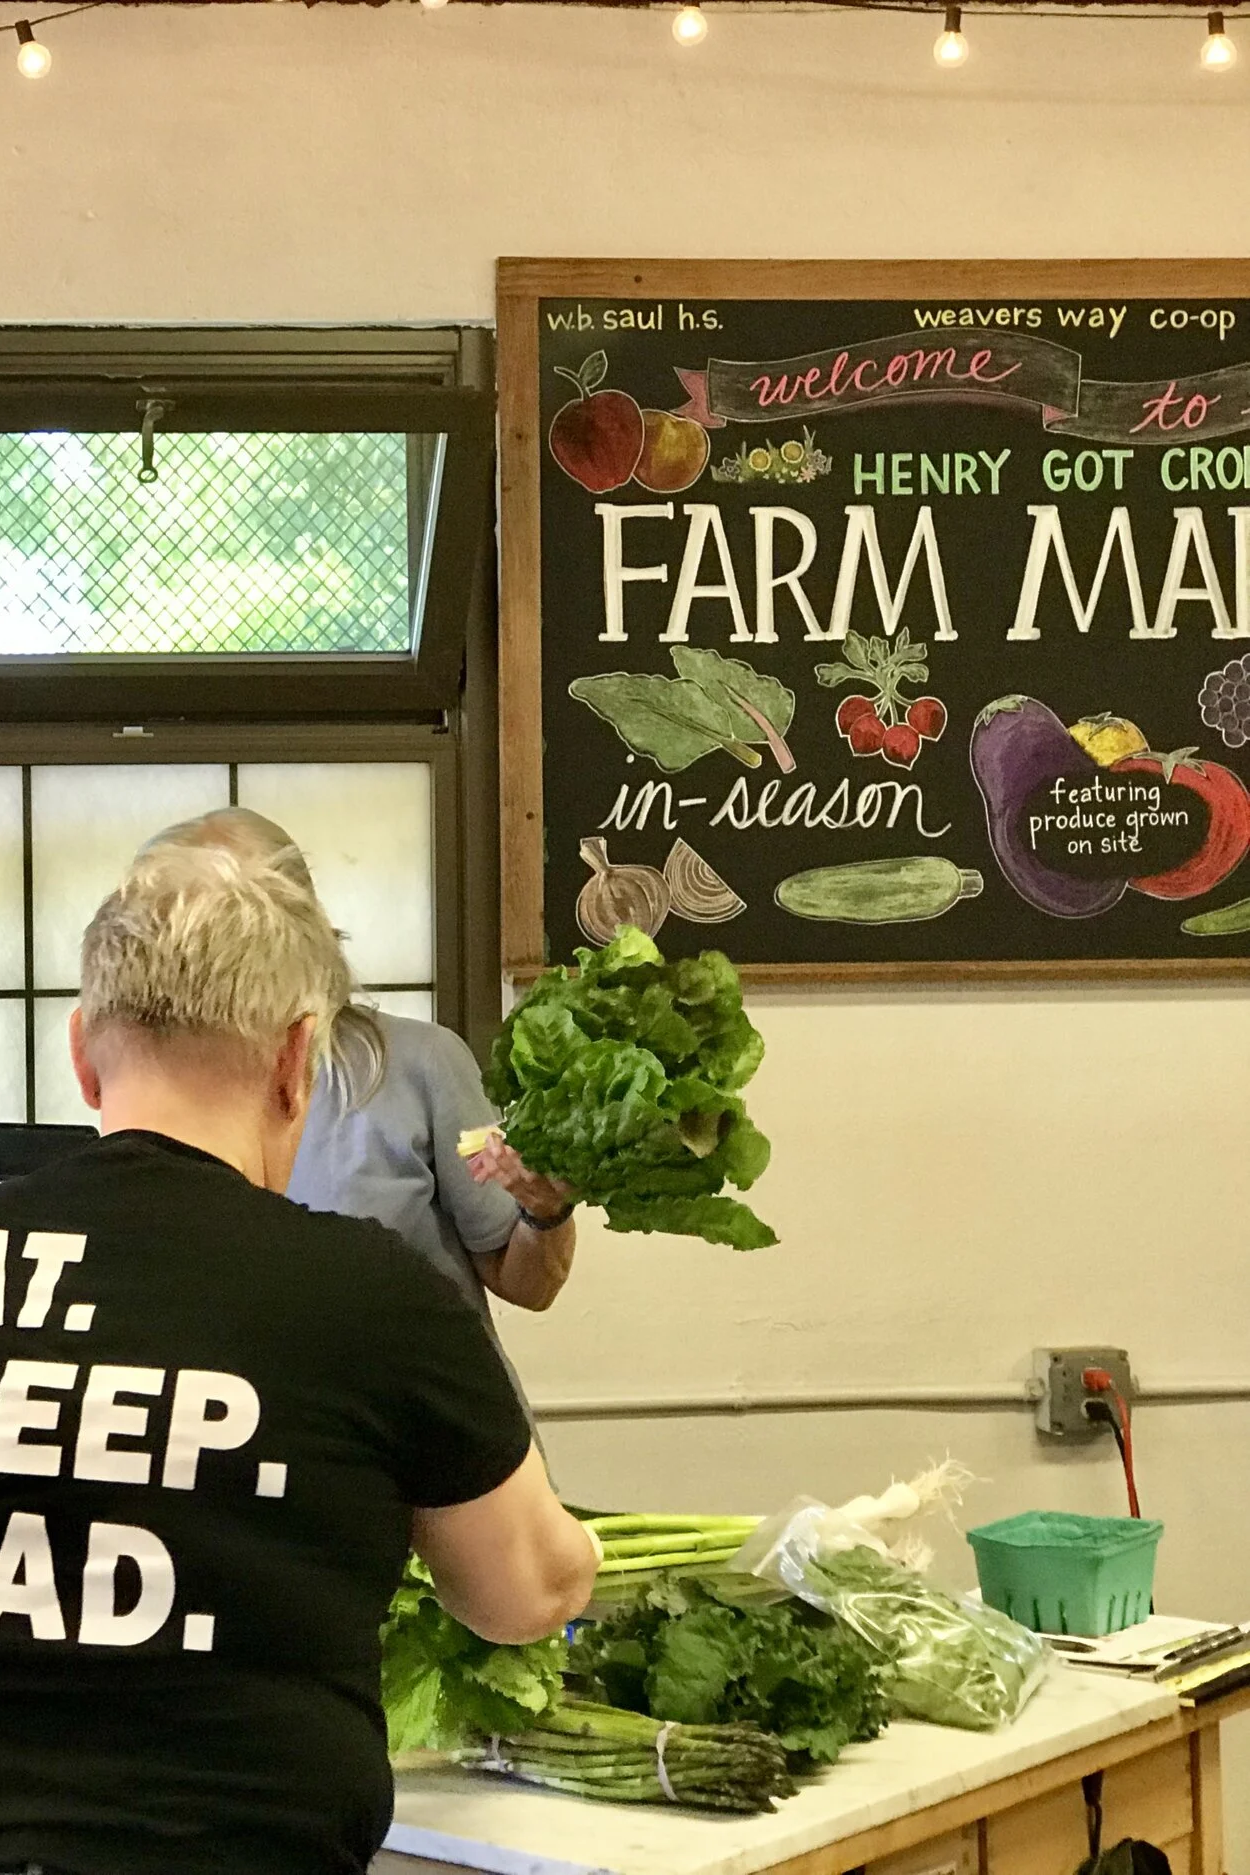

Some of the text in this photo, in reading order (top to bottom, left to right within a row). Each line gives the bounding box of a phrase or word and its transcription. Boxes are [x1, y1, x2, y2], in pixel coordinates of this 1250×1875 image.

[547, 304, 724, 331] w.b. saul h.s.
[914, 305, 1236, 341] weavers way co-op
[749, 343, 1022, 406] welcome
[1129, 381, 1221, 433] to
[853, 449, 1012, 495] HENRY
[1042, 449, 1134, 493] GOT
[594, 500, 959, 643] FARM
[597, 753, 952, 838] in-season
[1050, 777, 1162, 810] featuring
[1029, 808, 1189, 849] produce grown
[1066, 834, 1144, 855] on site
